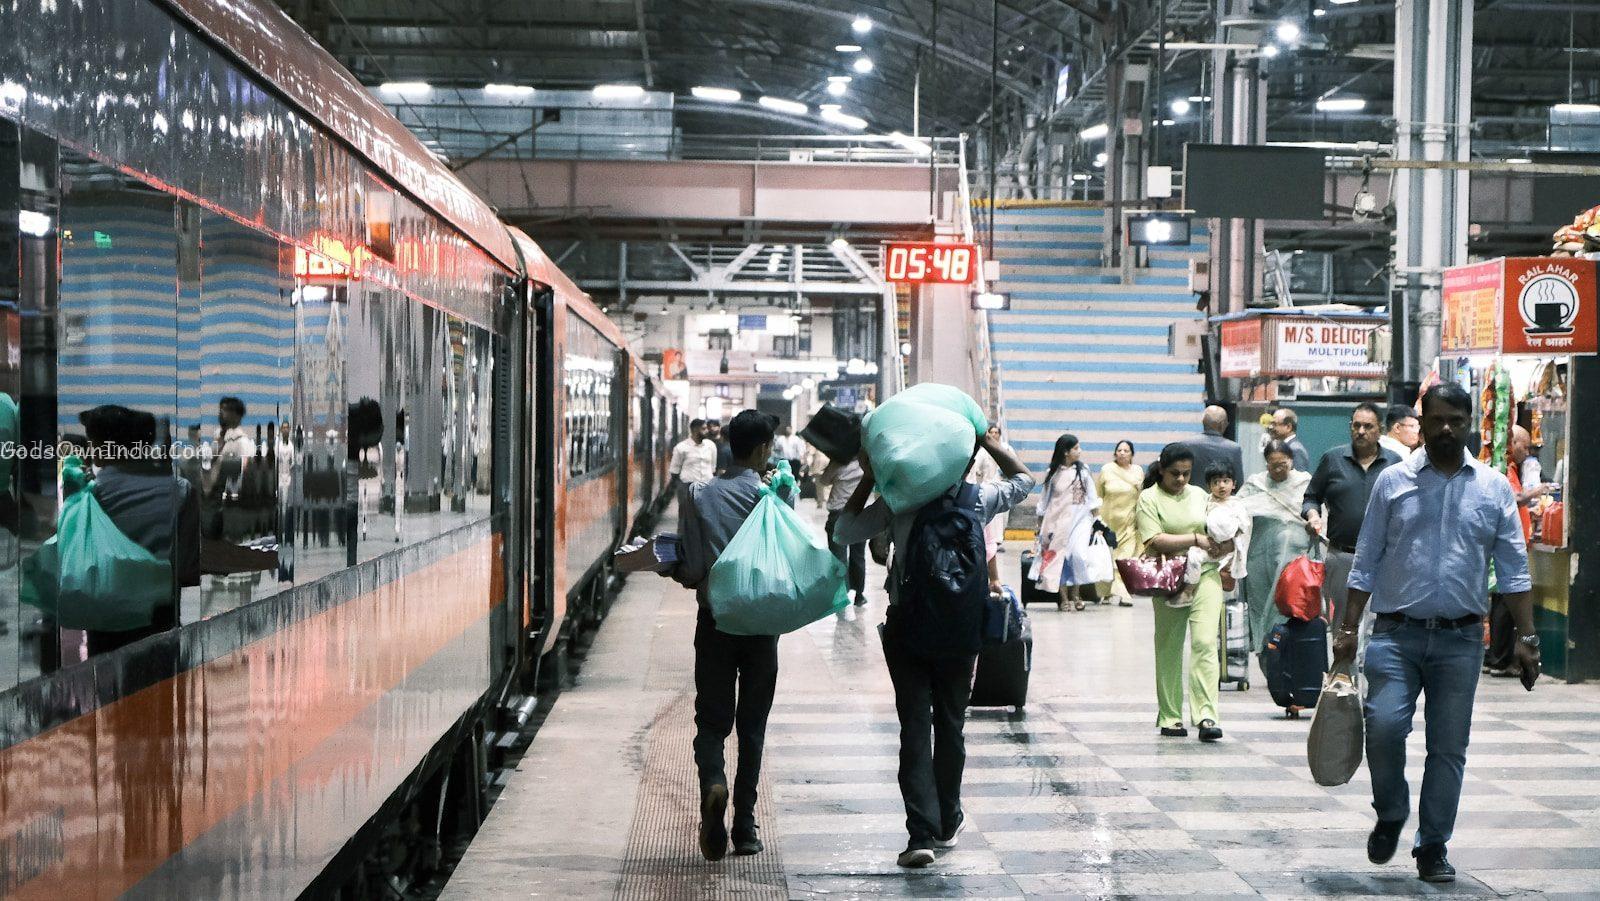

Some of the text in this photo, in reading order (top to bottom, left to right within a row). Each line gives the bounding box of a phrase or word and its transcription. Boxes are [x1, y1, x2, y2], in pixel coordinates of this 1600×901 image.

[889, 248, 970, 281] 05:48
[1517, 265, 1545, 285] RAIL
[1545, 263, 1579, 284] AHAR
[1284, 326, 1369, 345] M/S. DELICI
[1525, 334, 1574, 348] रेल आहार
[1308, 347, 1369, 357] MULTIPUR
